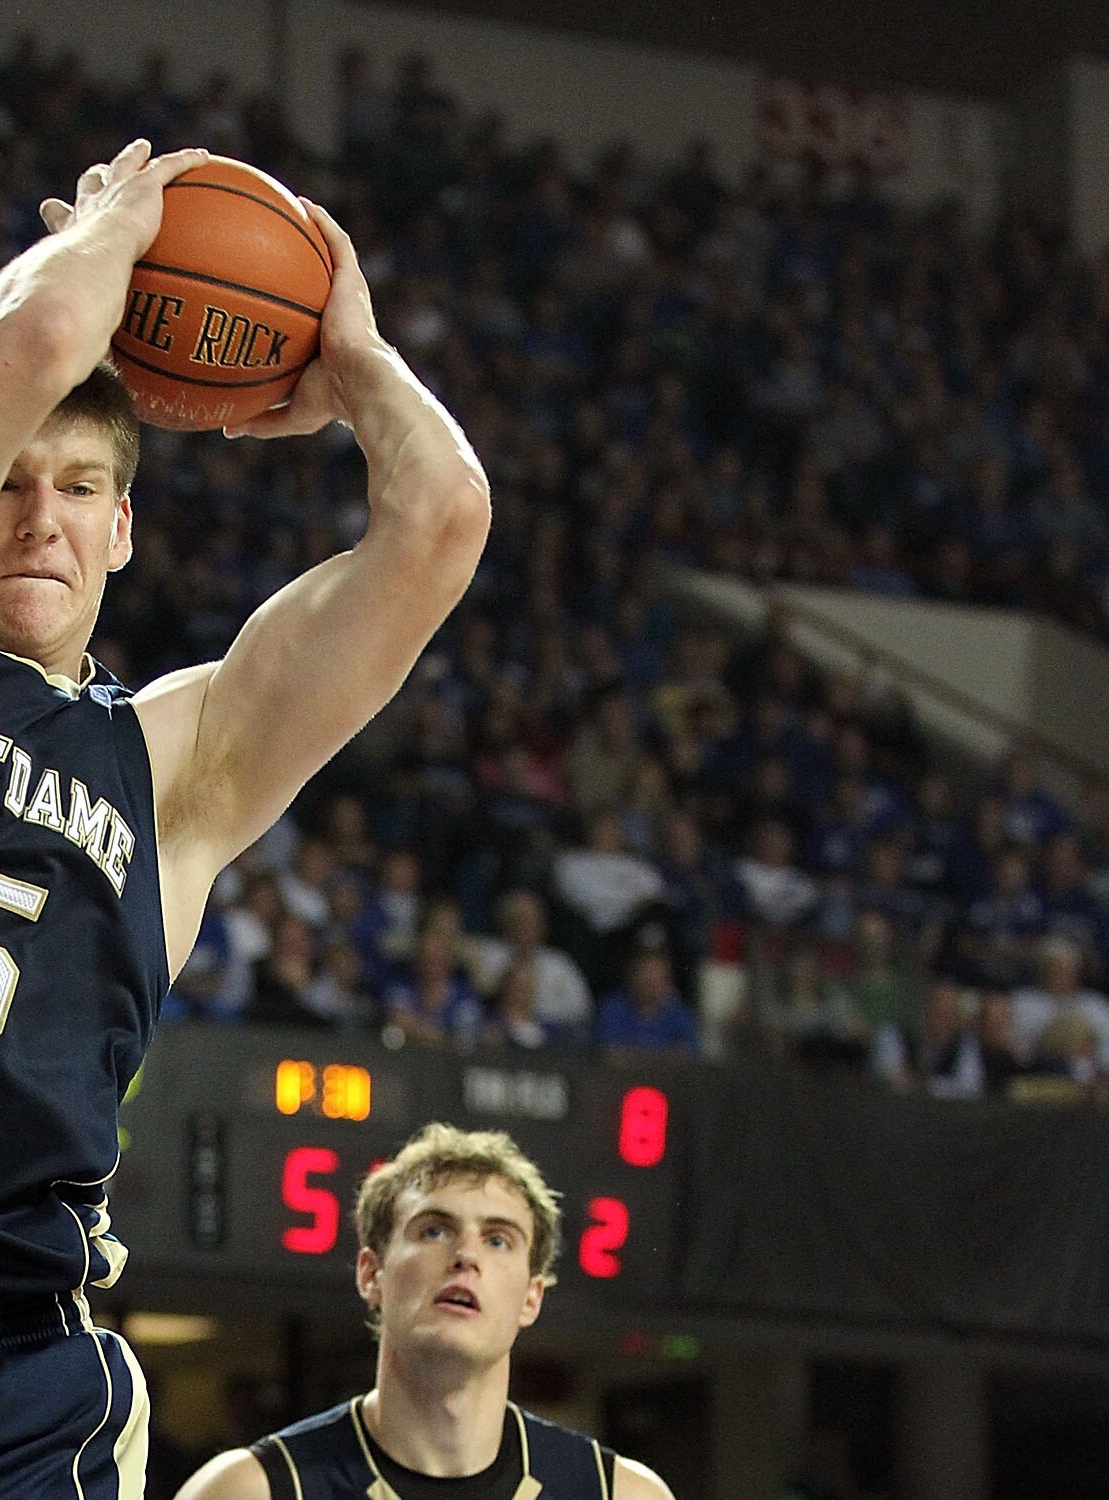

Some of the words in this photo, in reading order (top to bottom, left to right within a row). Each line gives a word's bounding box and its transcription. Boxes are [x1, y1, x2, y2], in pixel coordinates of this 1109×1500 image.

[122, 288, 185, 353] HE
[190, 304, 291, 369] ROCK
[3, 745, 136, 898] DAME
[578, 1196, 630, 1279] 2
